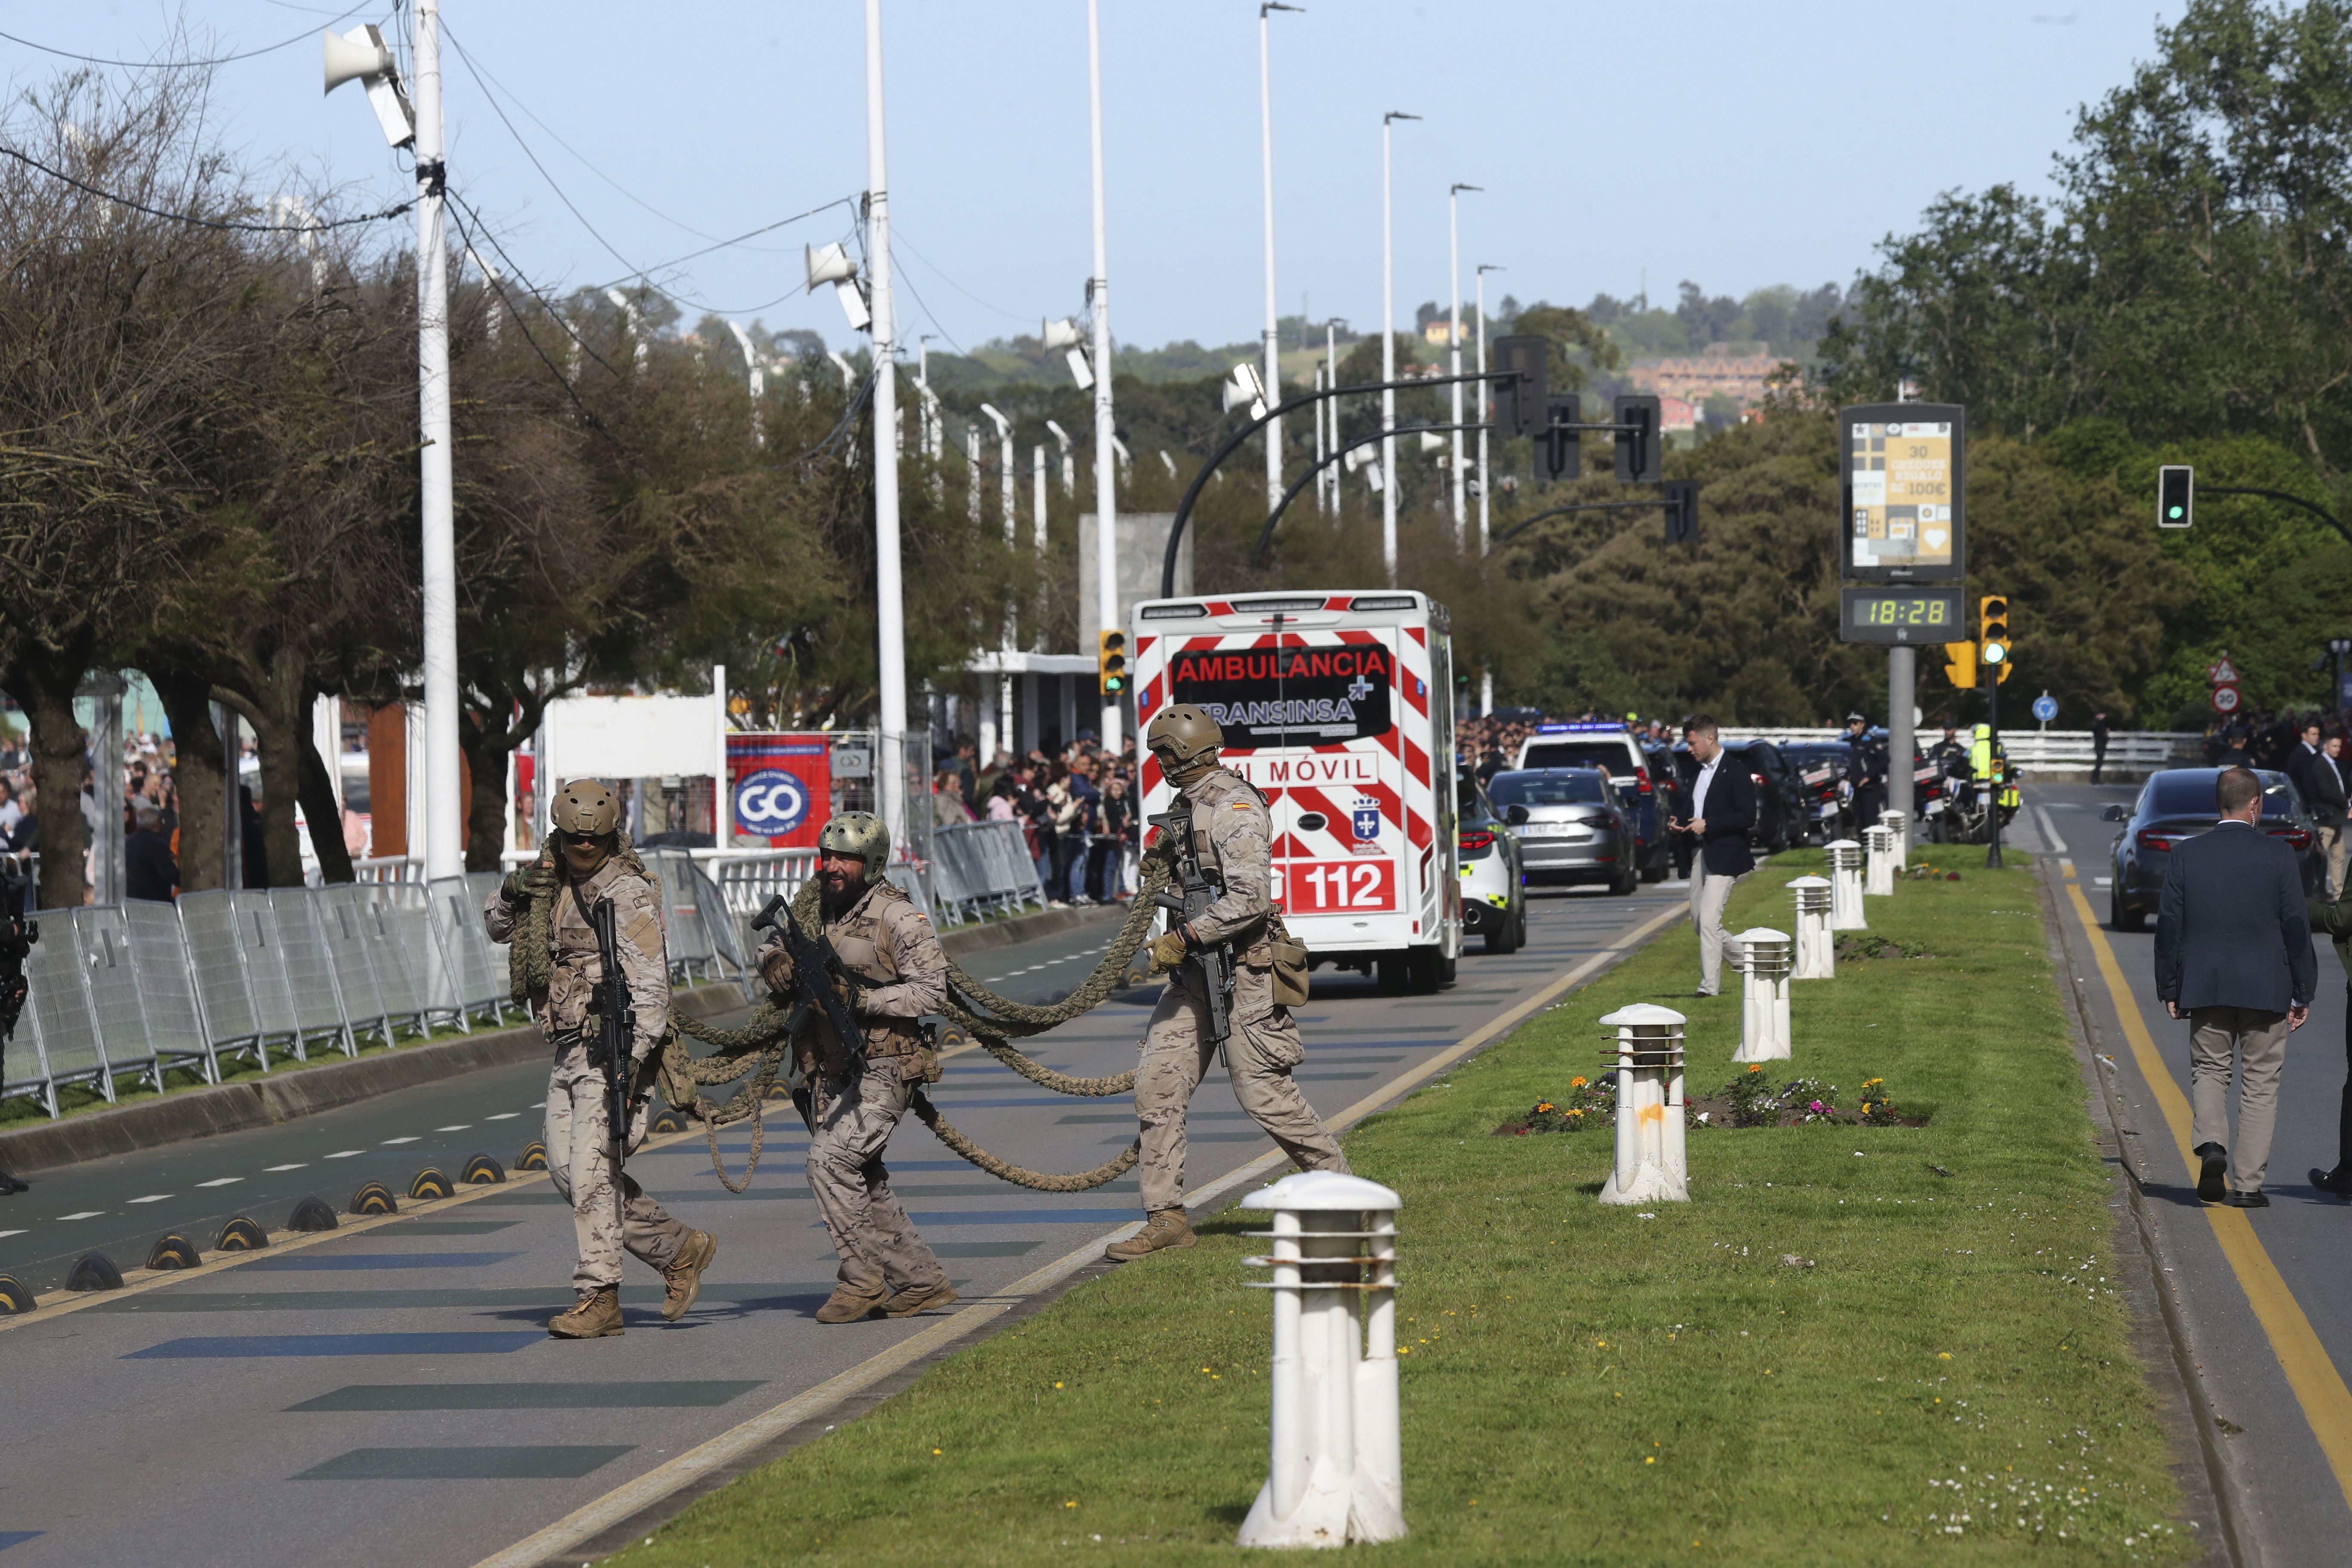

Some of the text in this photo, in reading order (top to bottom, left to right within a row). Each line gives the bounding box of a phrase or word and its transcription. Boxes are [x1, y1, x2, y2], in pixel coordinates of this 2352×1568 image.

[1909, 445, 1928, 458] 30
[1891, 459, 1946, 470] CHEQUES
[1895, 471, 1942, 481] REGALO
[1891, 482, 1905, 493] DE
[1909, 482, 1946, 495] 100€
[1870, 600, 1945, 624] 18:28
[1176, 651, 1386, 682] AMBULANCIA
[2218, 693, 2234, 704] 30
[1193, 697, 1357, 726] RANSINSA
[1270, 756, 1371, 781] MÓVIL
[738, 784, 802, 822] GO
[1305, 864, 1382, 908] 112
